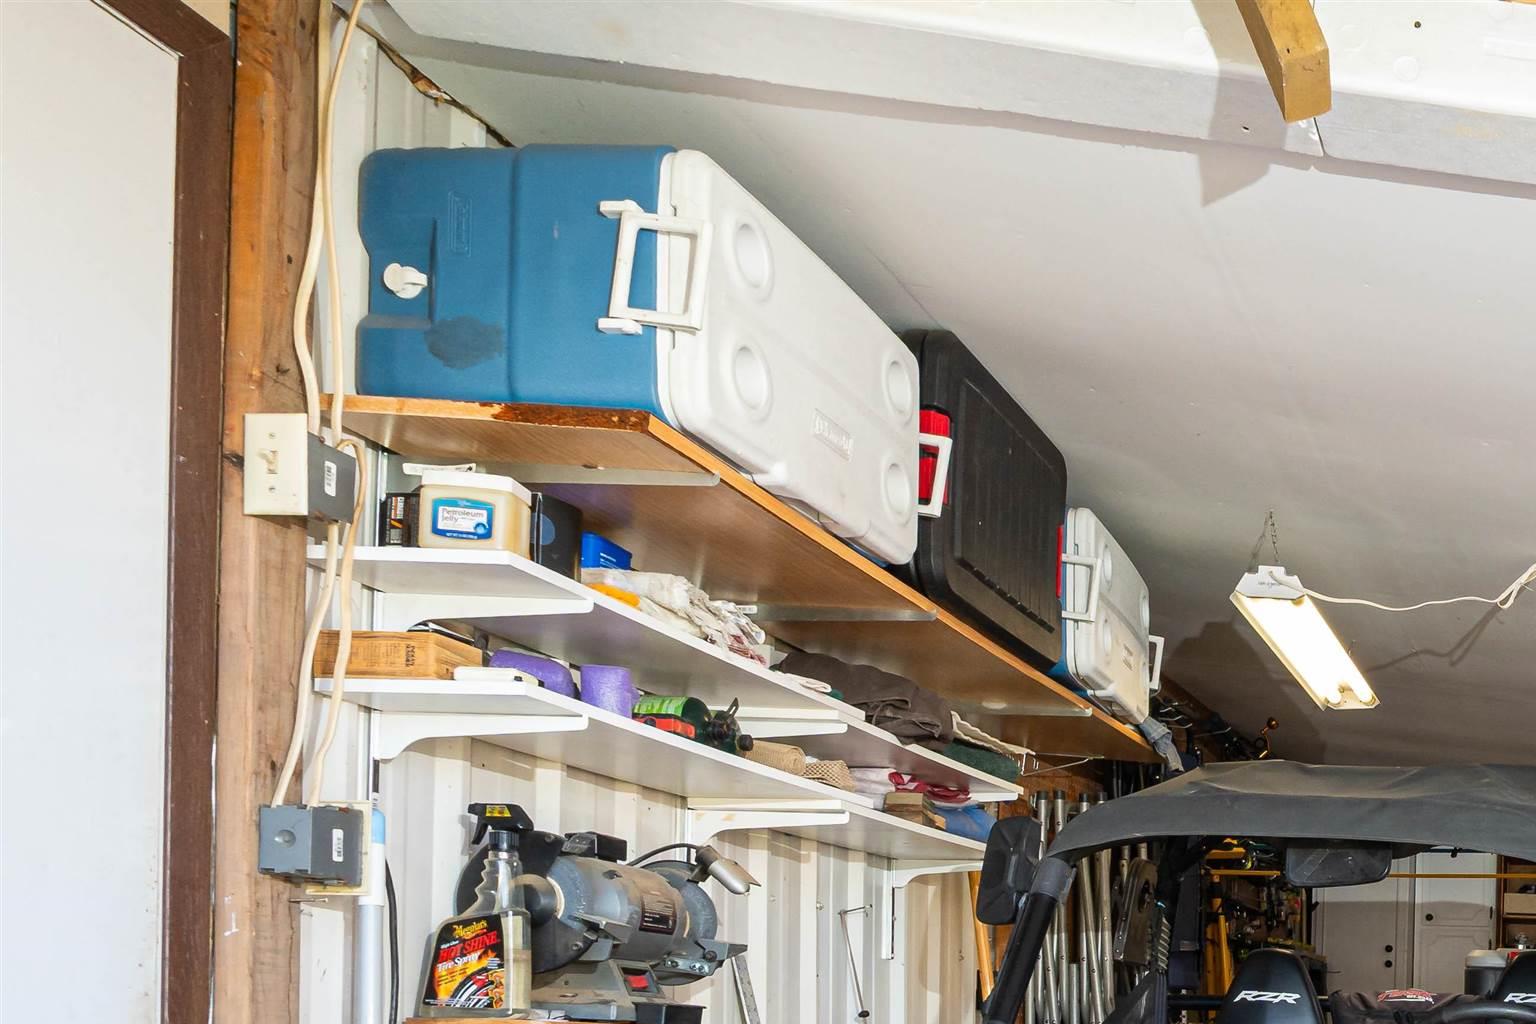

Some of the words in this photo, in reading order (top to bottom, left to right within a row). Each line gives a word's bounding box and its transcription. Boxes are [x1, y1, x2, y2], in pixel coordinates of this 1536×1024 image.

[441, 508, 485, 518] Petroleum
[441, 516, 460, 524] Jelly
[438, 944, 462, 963] HOT
[463, 931, 499, 953] SHINE
[437, 960, 455, 972] Tire
[454, 952, 481, 968] Spray
[1233, 990, 1301, 1005] RZR
